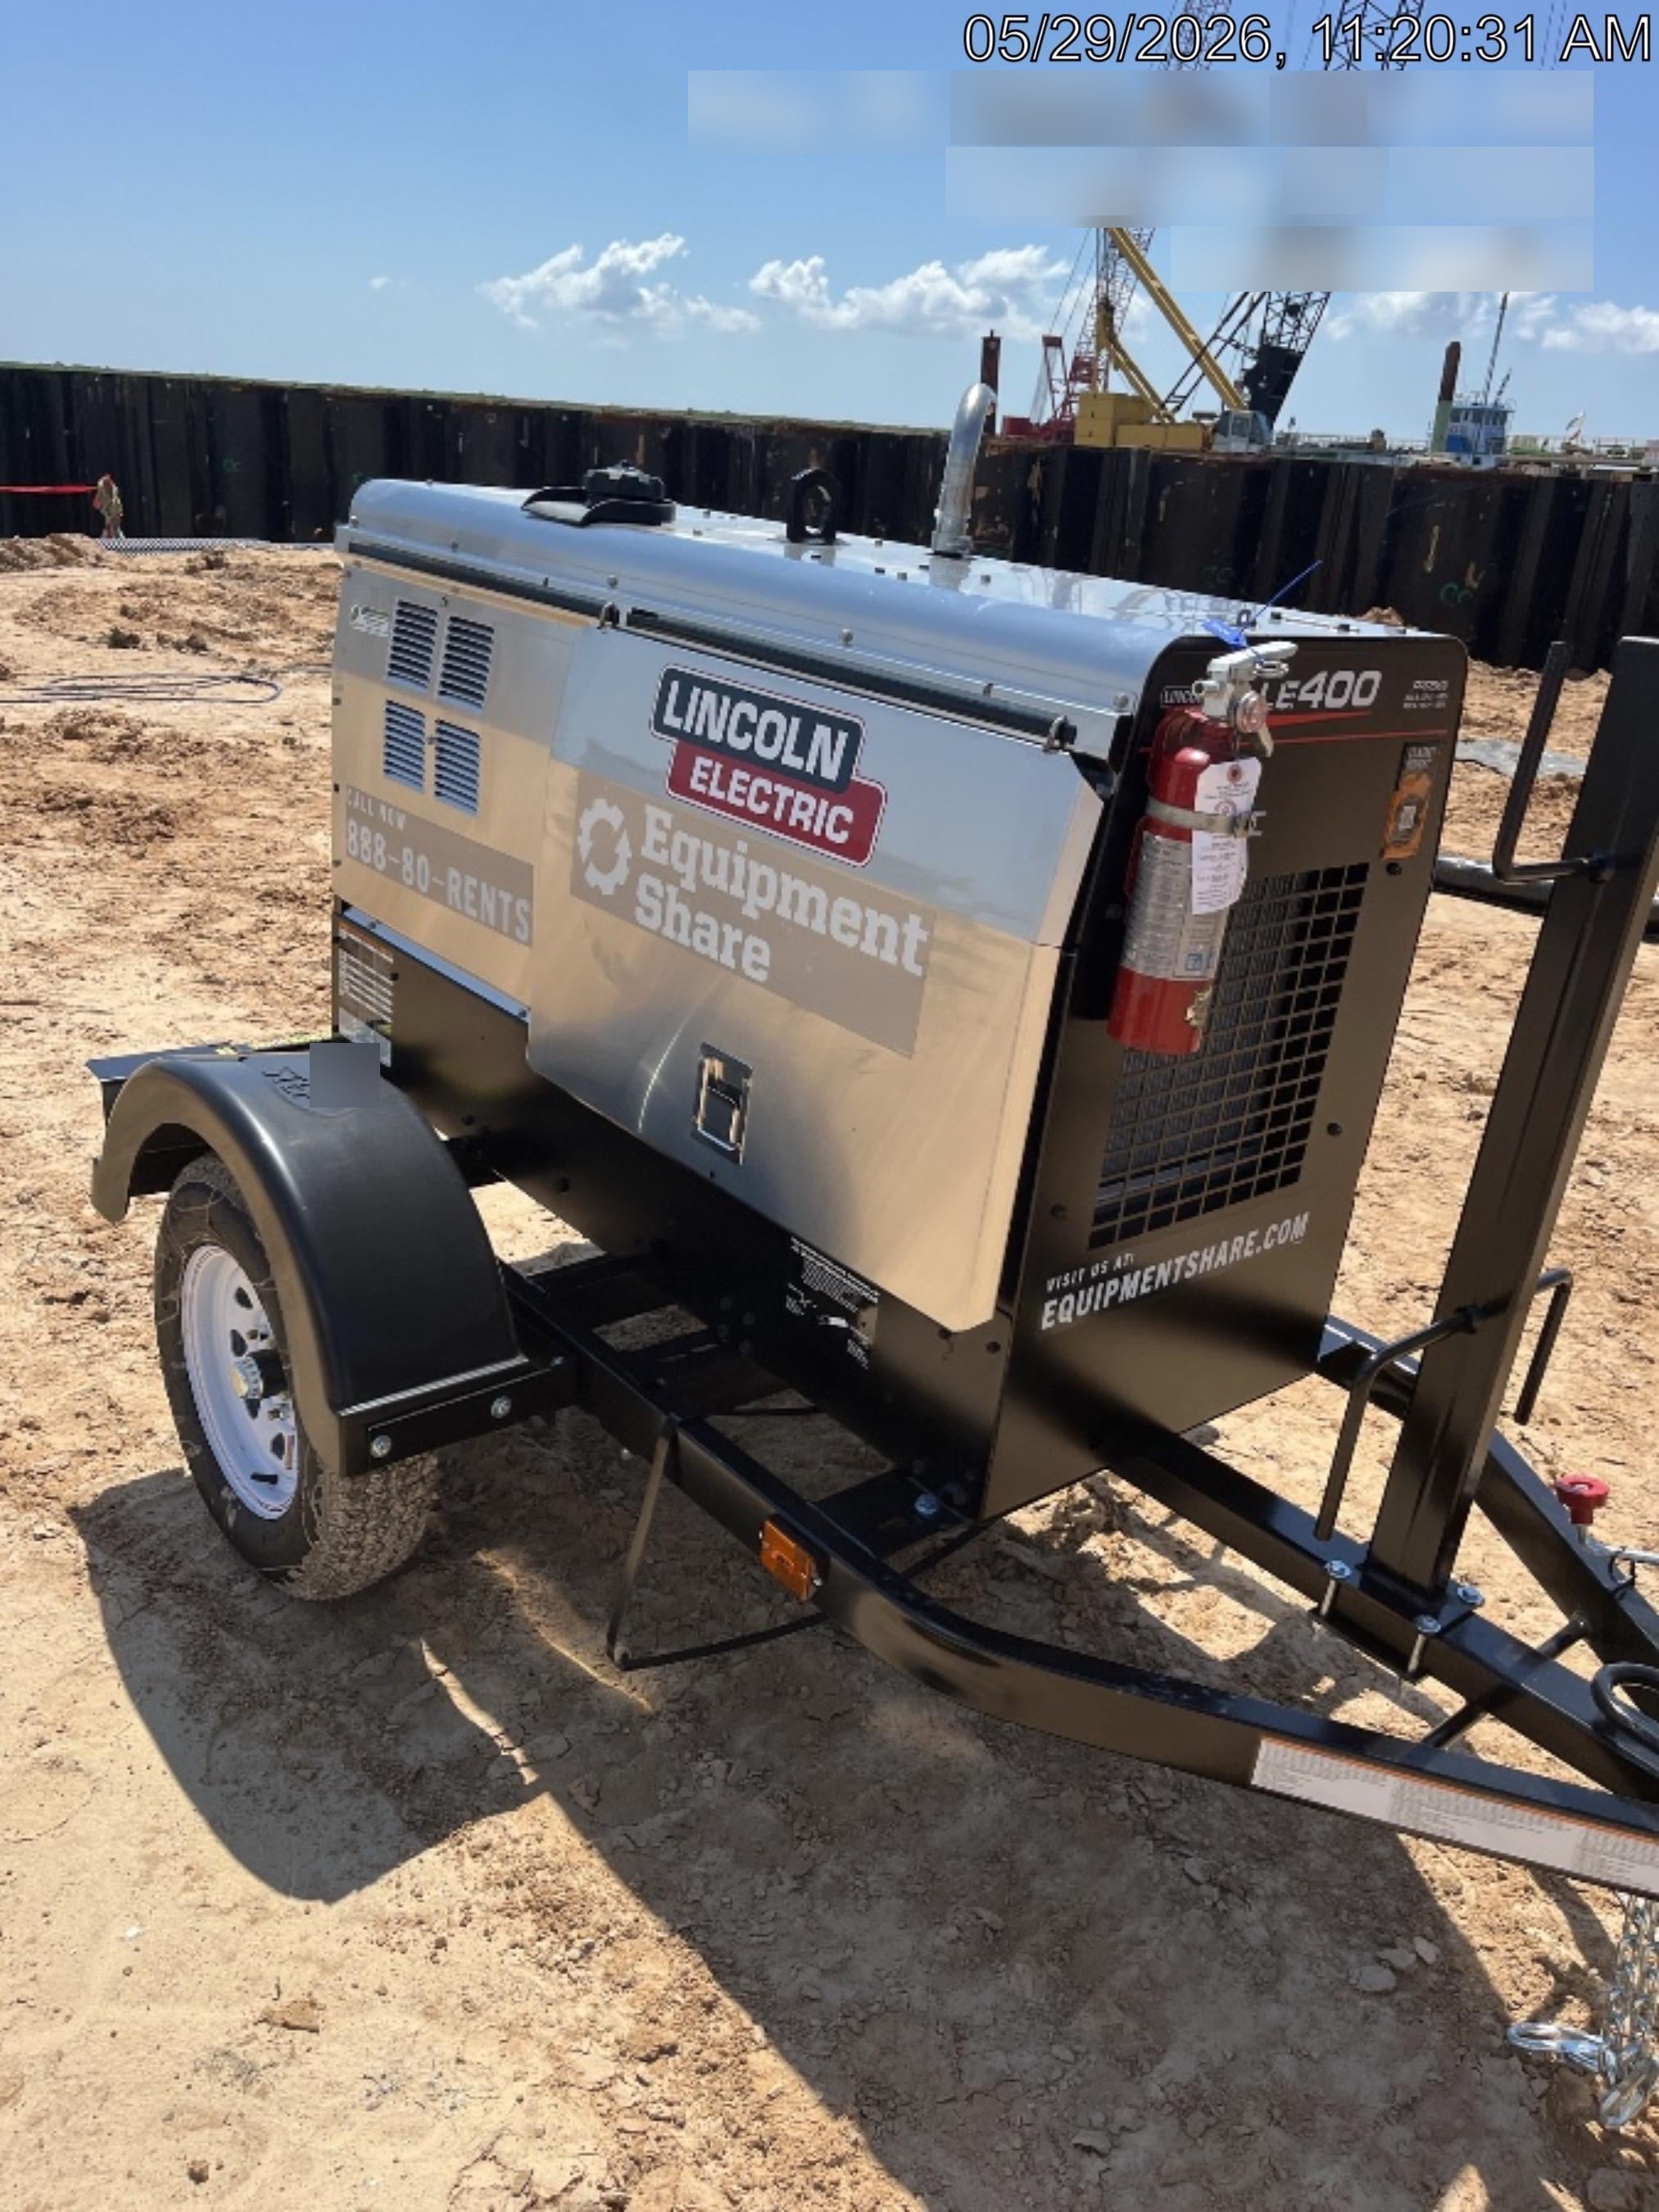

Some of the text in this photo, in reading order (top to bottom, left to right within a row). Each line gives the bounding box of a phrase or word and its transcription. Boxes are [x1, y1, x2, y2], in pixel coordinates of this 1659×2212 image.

[662, 679, 850, 782] LINCOLN
[347, 787, 374, 817] CALL
[689, 755, 854, 845] ELECTRIC
[347, 818, 531, 944] 888-80-RENTS
[634, 873, 771, 983] Share
[641, 804, 930, 977] Equipment
[1040, 1211, 1310, 1331] EQUIPMENTSHARE.COM
[1046, 1267, 1086, 1294] VISIT
[1090, 1260, 1109, 1279] US
